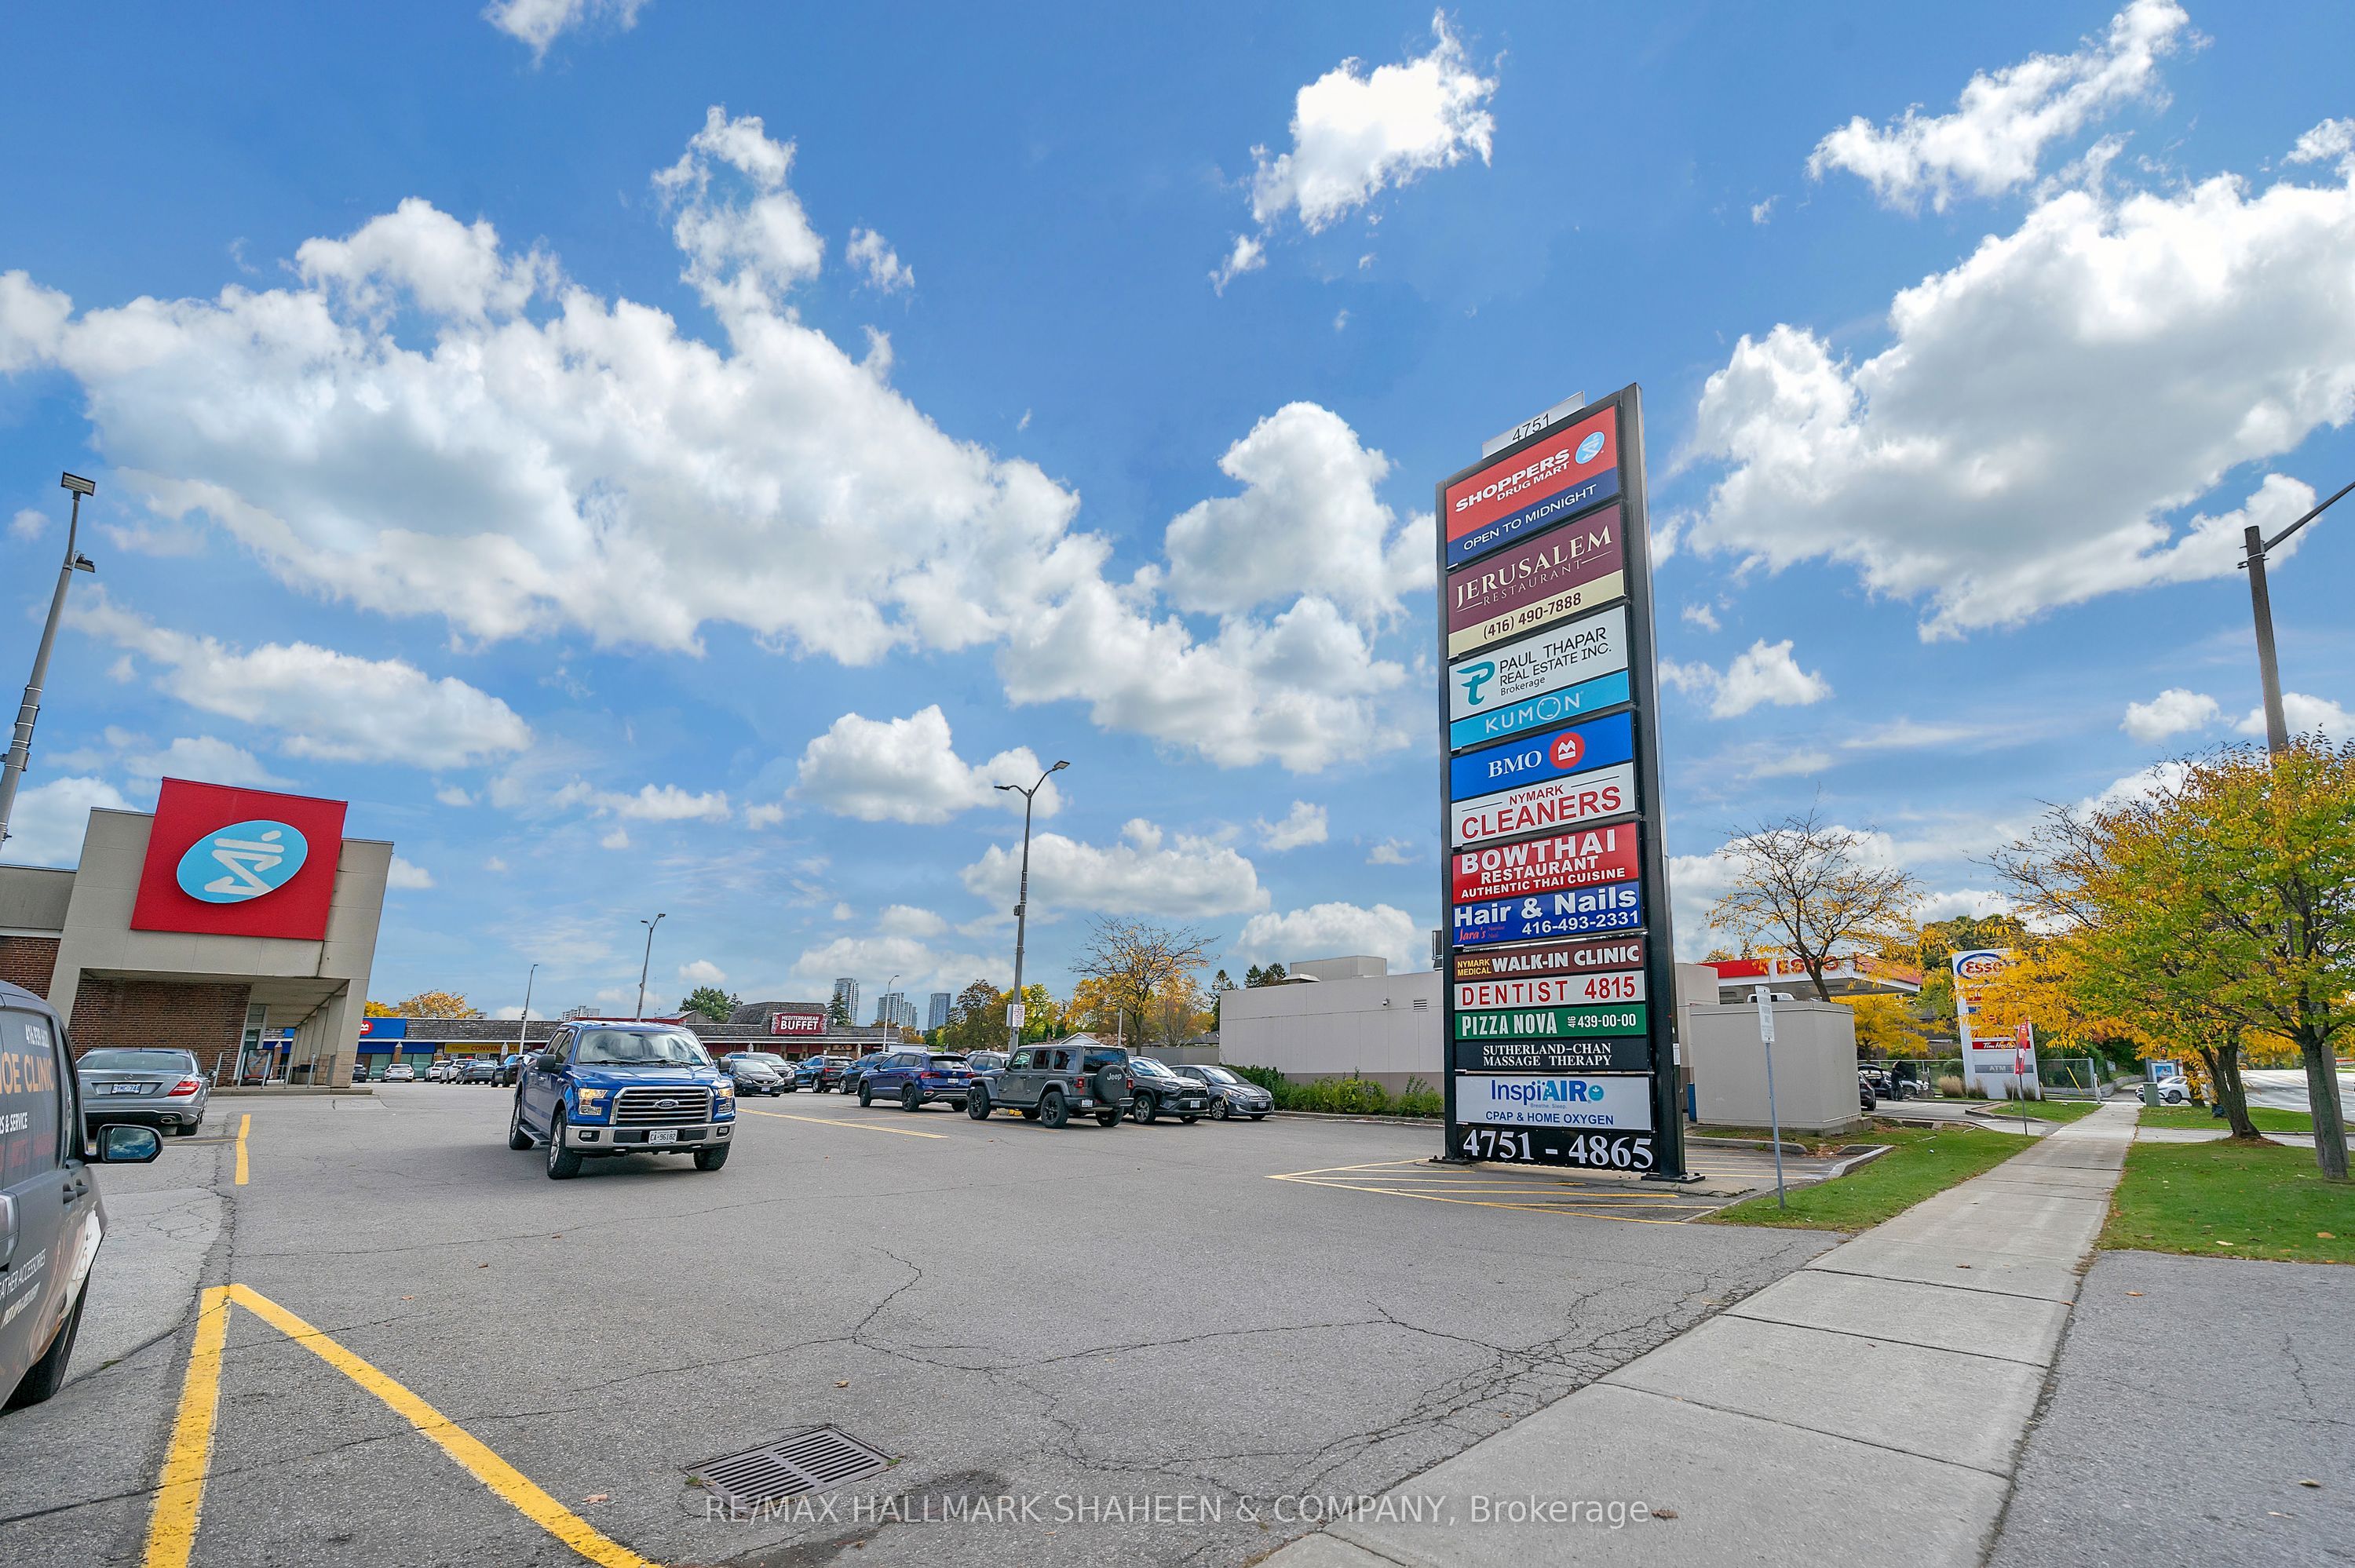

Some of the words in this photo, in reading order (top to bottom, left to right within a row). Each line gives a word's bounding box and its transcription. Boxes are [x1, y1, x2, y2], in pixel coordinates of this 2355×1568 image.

[1512, 413, 1550, 442] 4751
[1455, 448, 1570, 512] SHOPPERS
[1497, 481, 1531, 501] DRUG
[1533, 461, 1570, 483] MART
[1463, 527, 1499, 550] OPEN
[1502, 518, 1521, 532] TO
[1525, 483, 1597, 524] MIDNIGHT
[1456, 525, 1612, 608] JERUSALEM
[1484, 559, 1582, 605] RESTAURANT
[1484, 615, 1514, 640] (416)
[1518, 592, 1581, 625] 490-7888
[1499, 651, 1536, 673] PAUL
[1543, 626, 1606, 658] THAPAR
[1500, 665, 1530, 686] REAL
[1533, 652, 1577, 675] ESTATE
[1581, 642, 1611, 660] INC.
[1500, 676, 1545, 696] Brokerage
[1485, 692, 1580, 733] KUMON
[1488, 750, 1542, 778] BMO
[1509, 784, 1564, 805] NYMARK
[1462, 786, 1621, 839] CLEANERS
[1461, 829, 1616, 874] BOWTHAI
[1461, 881, 1529, 898] AUTHENTIC
[1532, 877, 1564, 888] THAI
[1567, 868, 1625, 883] CUISINE
[1481, 855, 1598, 884] RESTAURANT
[1454, 903, 1511, 928] Hair
[1521, 897, 1543, 919] &
[1554, 886, 1636, 915] Nails
[1522, 910, 1638, 935] 416-493-2331
[1457, 958, 1490, 968] NYMARK
[1457, 967, 1492, 976] MEDICAL
[1492, 951, 1568, 972] WALK-IN
[1574, 945, 1640, 966] CLINIC
[1462, 980, 1568, 1006] DENTIST
[1584, 975, 1636, 999] 4815
[780, 1020, 818, 1030] BUFFET
[1462, 1015, 1508, 1037] PIZZA
[1513, 1012, 1557, 1034] NOVA
[1577, 1013, 1636, 1028] 439-00-00
[1483, 1043, 1611, 1055] SUTHERLAND-CHAN
[1483, 1056, 1541, 1067] MASSAGE
[1549, 1055, 1612, 1067] THERAPY
[24, 1055, 55, 1092] CLINIC
[1107, 1072, 1123, 1081] Jeep
[9, 1111, 27, 1132] SERVICE
[1485, 1110, 1513, 1121] CPAP
[1517, 1112, 1524, 1121] &
[1528, 1113, 1560, 1123] HOME
[1563, 1114, 1614, 1125] OXYGEN
[1462, 1129, 1534, 1160] 4751
[1568, 1134, 1653, 1169] 4865
